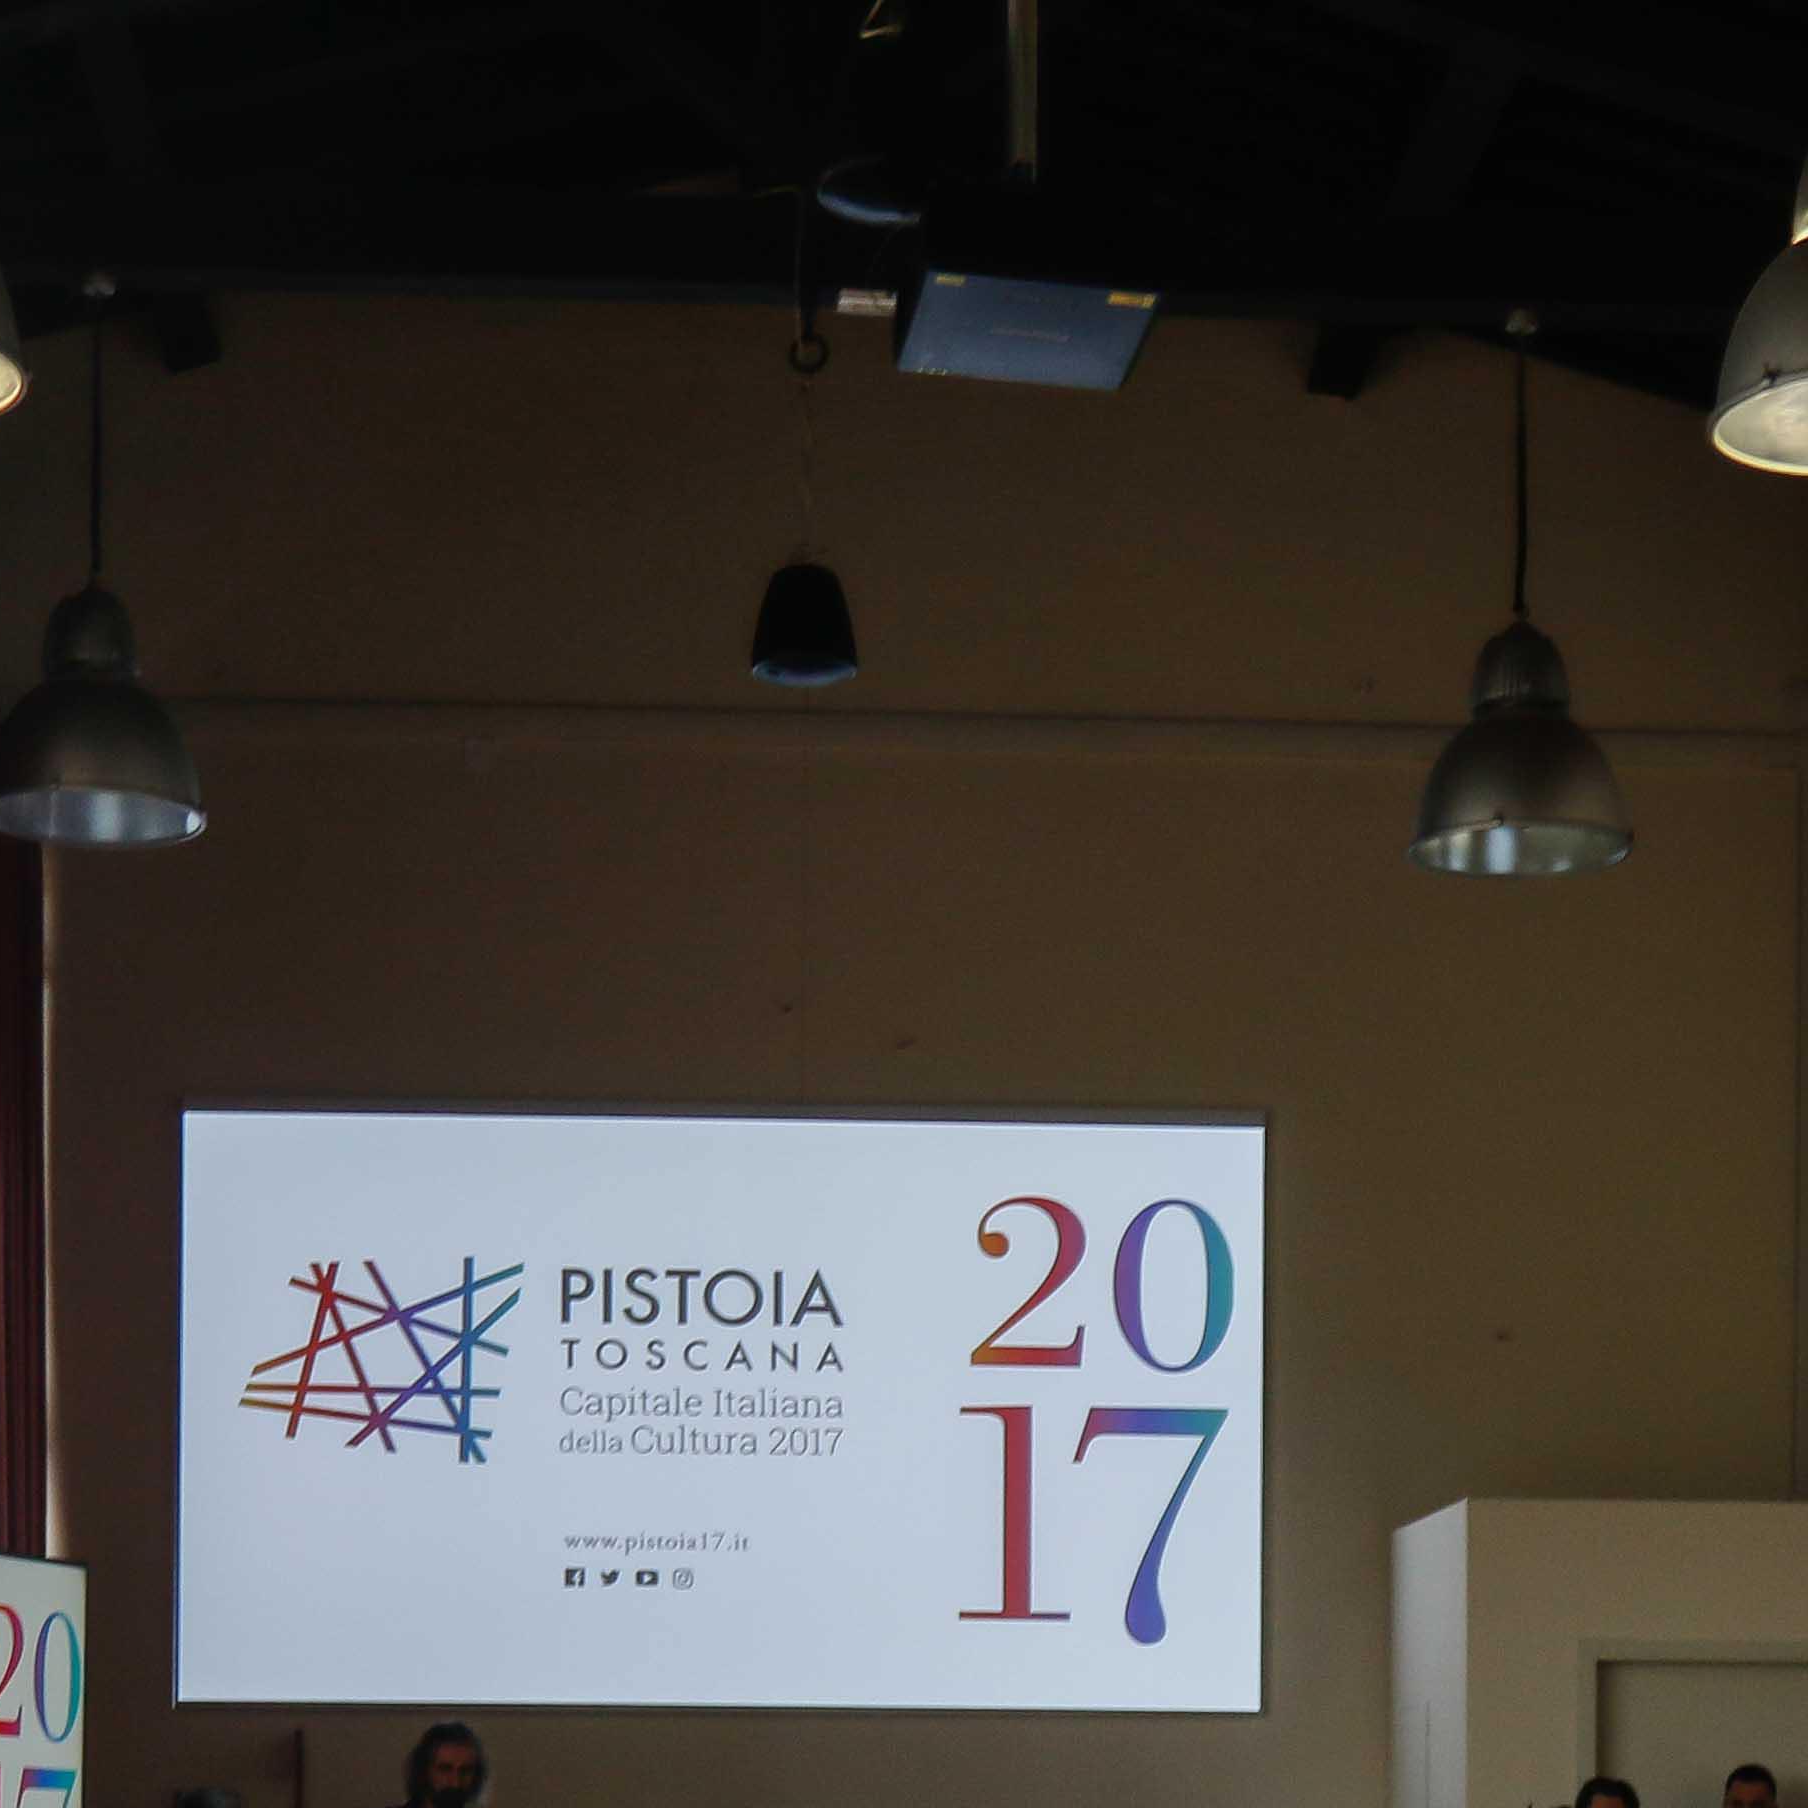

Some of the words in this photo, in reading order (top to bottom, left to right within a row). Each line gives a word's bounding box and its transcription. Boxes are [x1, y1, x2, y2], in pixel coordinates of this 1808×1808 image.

[560, 1266, 844, 1328] PISTOIA
[969, 1195, 1235, 1375] 20
[561, 1338, 844, 1373] TOSCANA
[560, 1386, 703, 1422] Capitale
[714, 1388, 843, 1419] Italiana
[560, 1430, 623, 1455] della
[630, 1424, 757, 1456] Cultura
[768, 1427, 844, 1457] 2017
[958, 1404, 1230, 1647] 17
[564, 1532, 750, 1556] www.pistoia17.it
